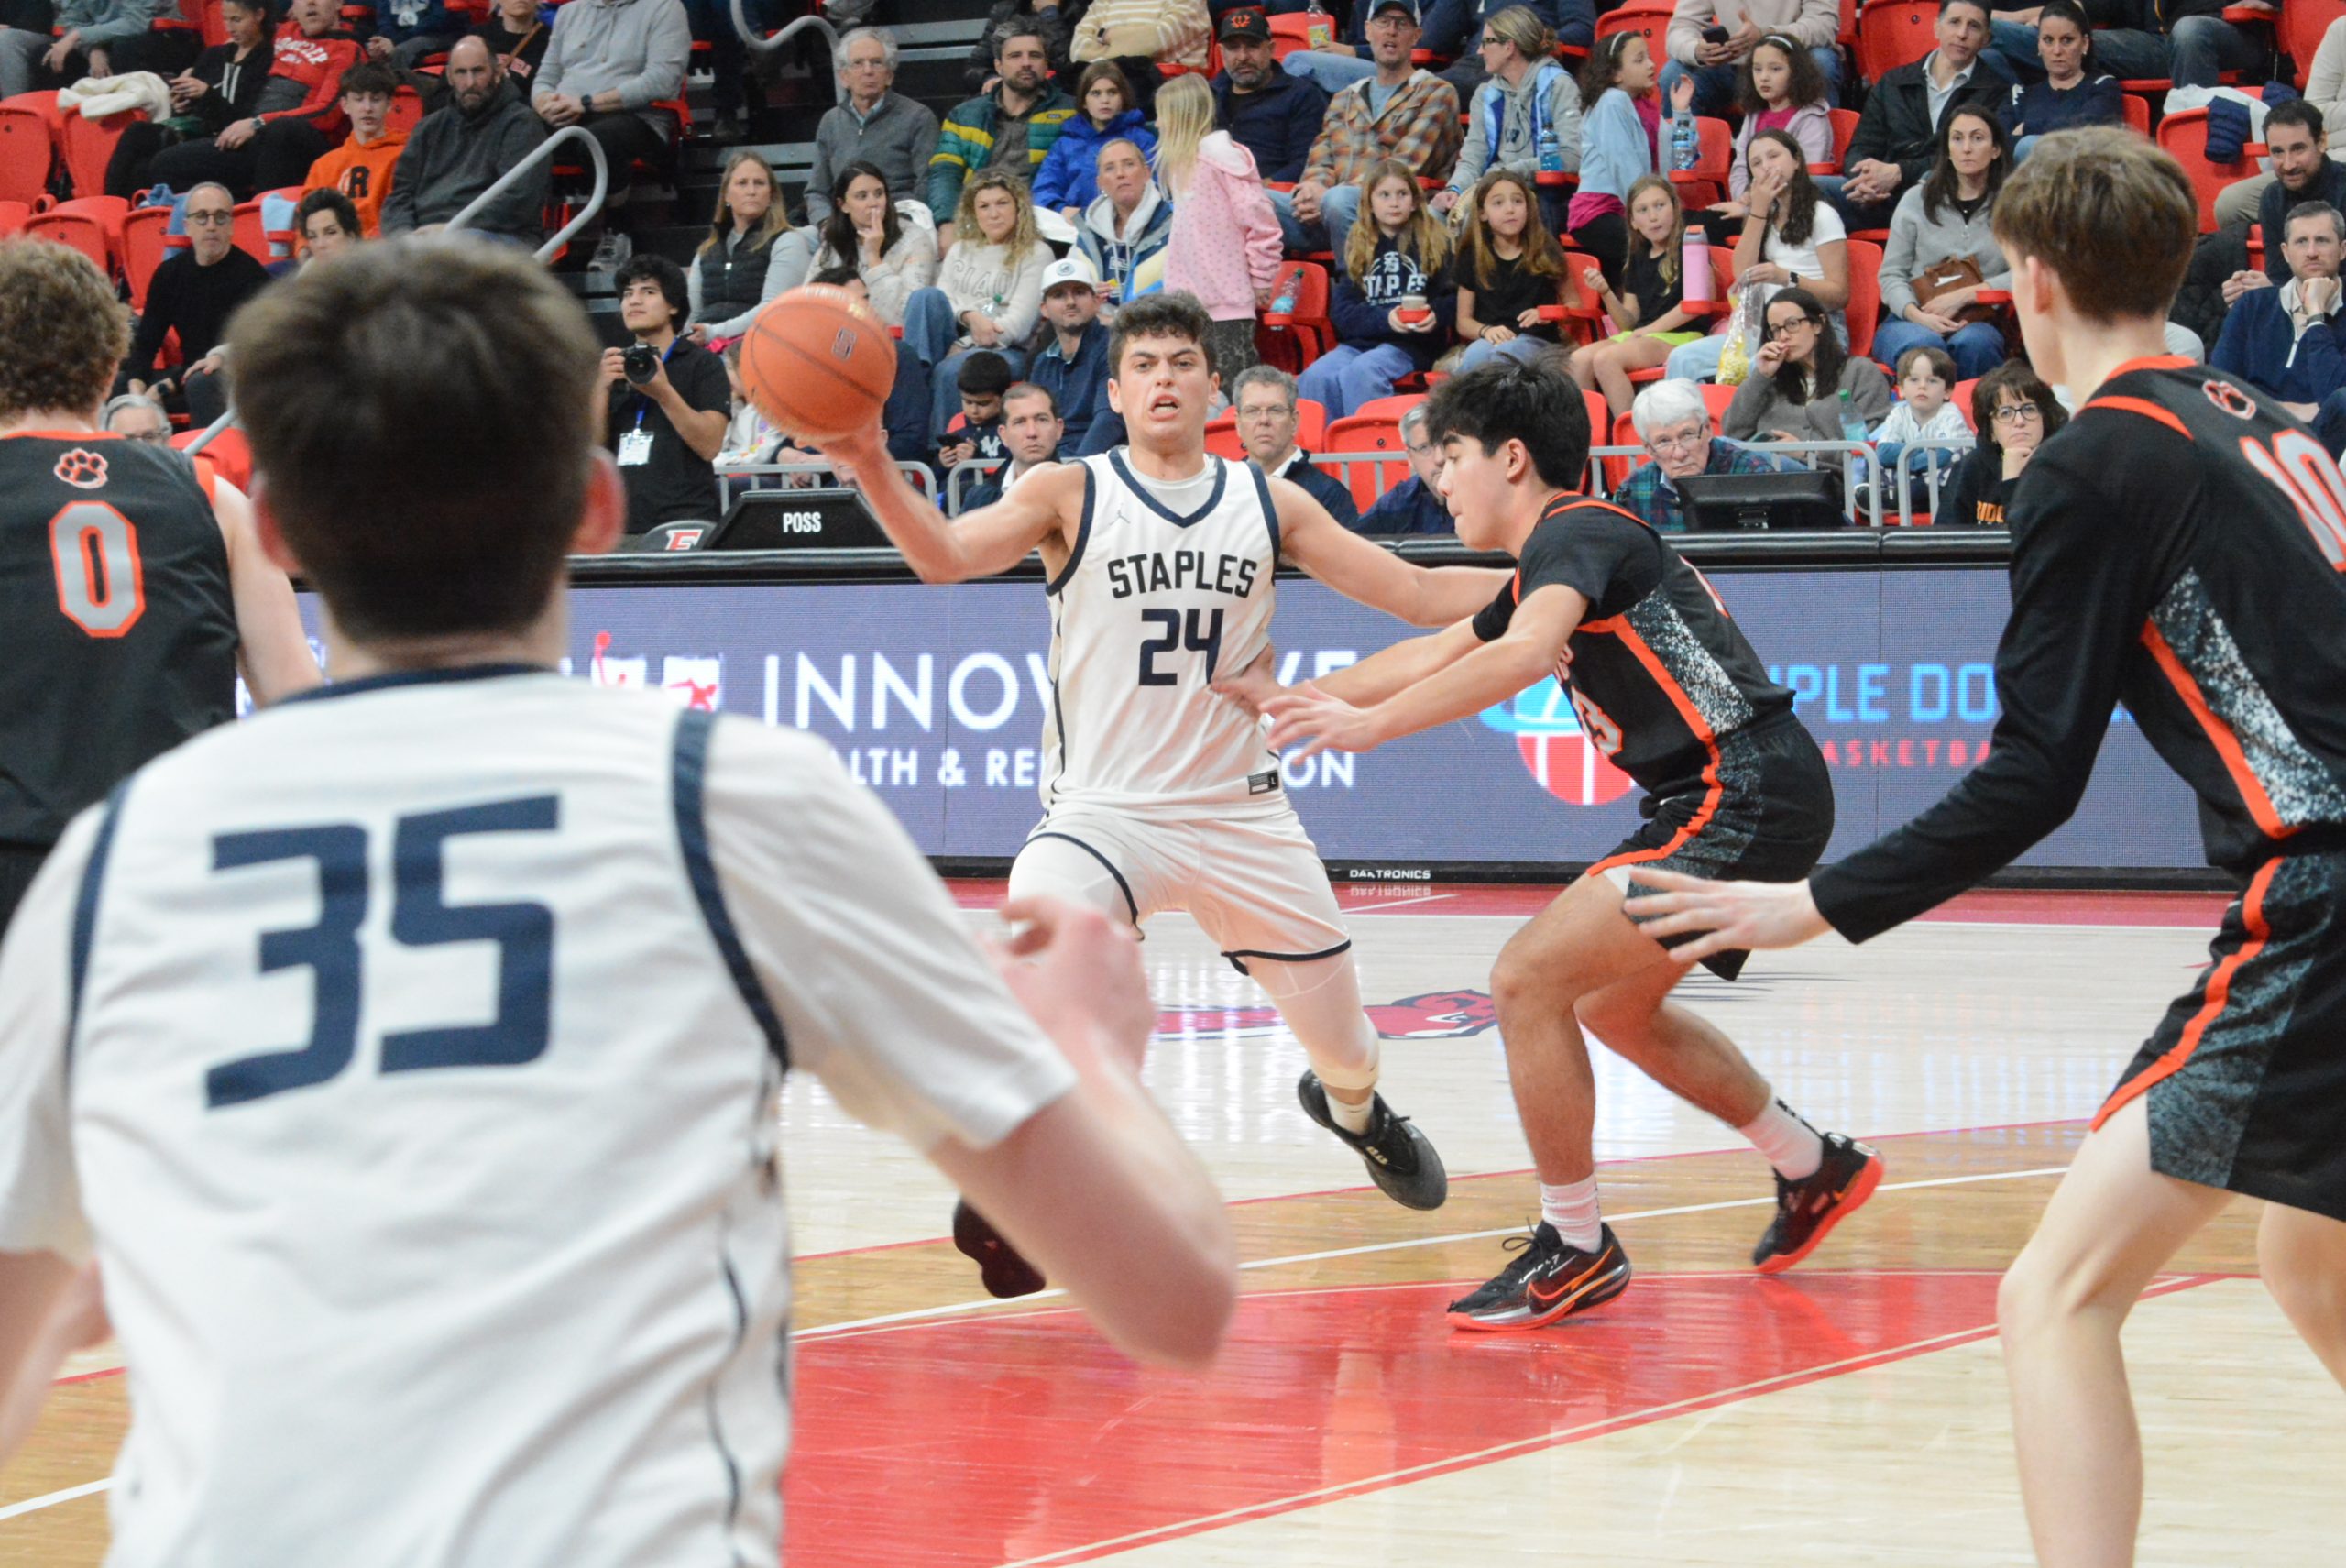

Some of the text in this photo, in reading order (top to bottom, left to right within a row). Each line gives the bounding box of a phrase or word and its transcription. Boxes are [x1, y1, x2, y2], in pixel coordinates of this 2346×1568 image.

[348, 165, 370, 198] R
[783, 511, 822, 533] POSS
[2239, 429, 2346, 572] 10
[49, 500, 146, 638] 0
[1107, 550, 1257, 598] STAPLES
[1138, 609, 1224, 686] 24
[937, 748, 966, 787] &
[203, 794, 561, 1112] 35
